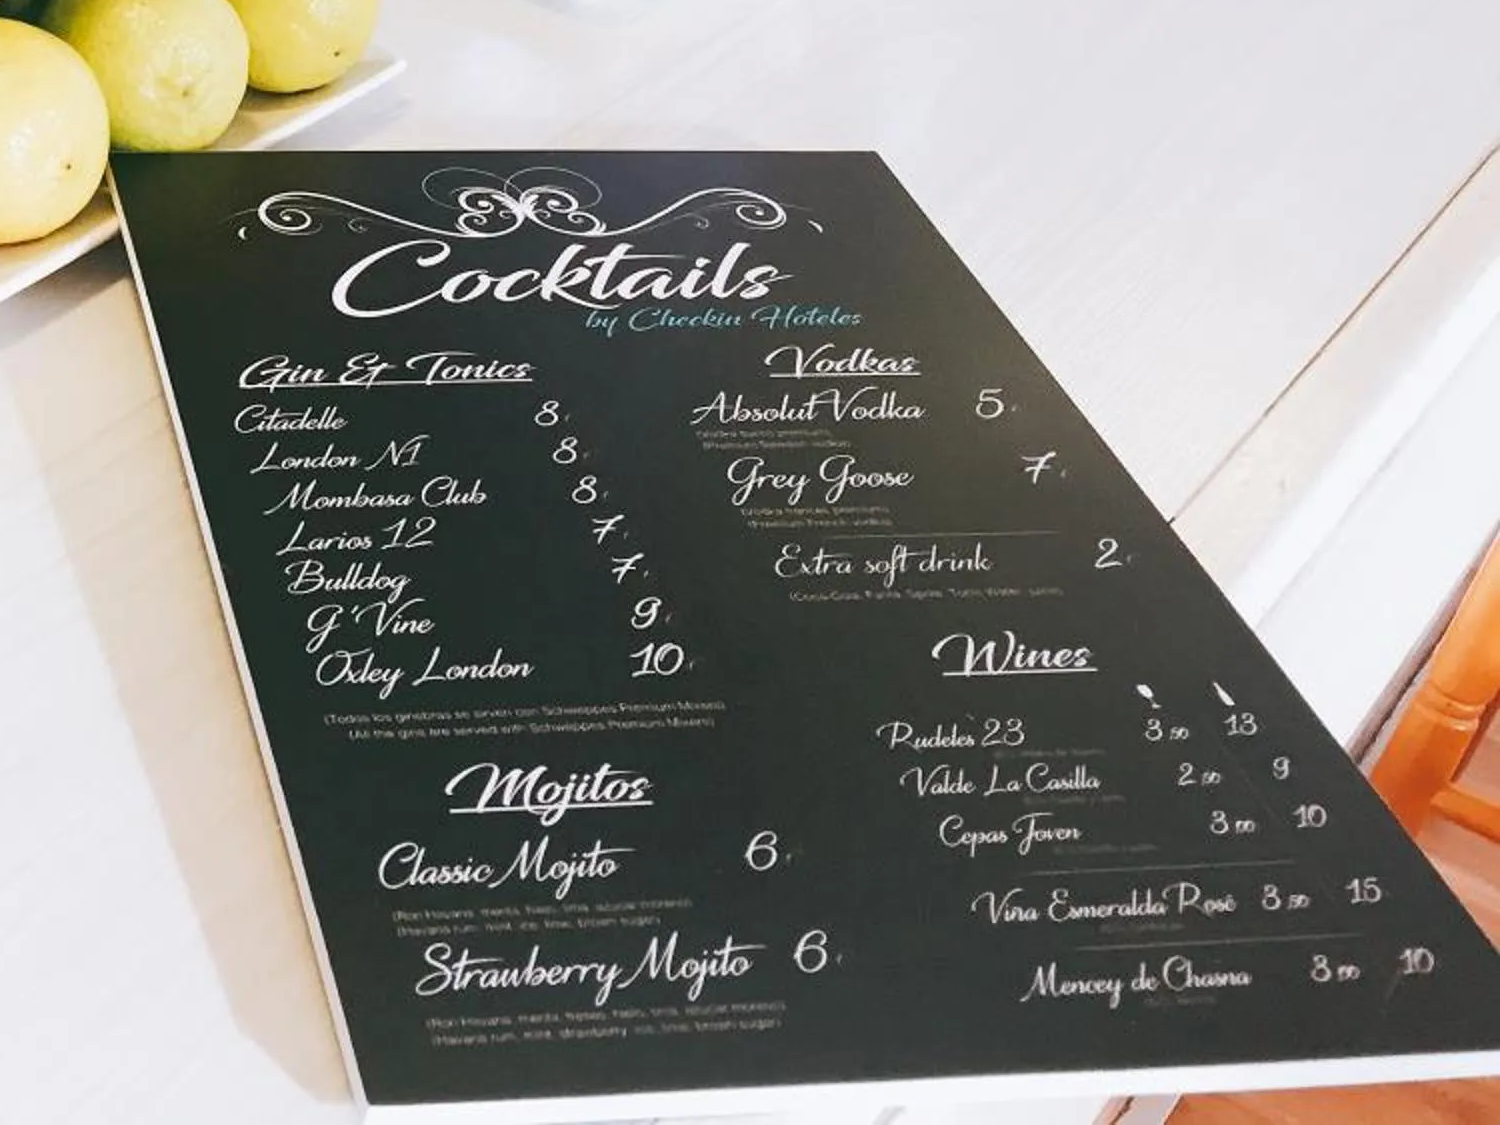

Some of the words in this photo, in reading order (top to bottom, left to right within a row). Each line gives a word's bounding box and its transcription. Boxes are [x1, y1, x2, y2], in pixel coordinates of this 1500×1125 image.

[331, 238, 794, 318] Cocktails
[586, 310, 618, 337] by
[628, 306, 741, 332] Checkin
[751, 305, 861, 330] Hoteles
[240, 355, 329, 393] Gin
[406, 351, 536, 386] Tonics
[764, 343, 922, 376] Vodkas
[234, 404, 348, 434] Citadelle
[534, 400, 560, 426] 8
[692, 391, 830, 426] Absolut
[822, 386, 926, 423] Vodka
[976, 388, 1003, 419] 5
[250, 441, 361, 475] London
[552, 436, 578, 464] 8
[727, 456, 811, 505] Grey
[819, 454, 915, 504] Goose
[1021, 450, 1057, 484] 7
[262, 479, 414, 515] Mombasa
[421, 476, 487, 508] Club
[571, 475, 597, 504] 8
[276, 521, 372, 556] Larios
[380, 516, 437, 550] 12
[592, 514, 625, 544] 7
[284, 559, 413, 603] Bulldog
[611, 552, 645, 584] 7
[774, 542, 852, 578] Extra
[864, 543, 916, 588] soft
[919, 542, 995, 573] drink
[1094, 538, 1122, 569] 2
[631, 596, 663, 630] 9
[316, 646, 405, 700] Oxley
[411, 646, 535, 686] London
[629, 641, 686, 678] 10
[931, 630, 1094, 676] Wines
[876, 721, 975, 753] Rudeles
[981, 718, 1025, 747] 23
[1145, 718, 1163, 742] 3
[1224, 712, 1258, 736] 13
[444, 762, 654, 827] Mojitos
[899, 764, 978, 797] Valde
[983, 764, 1022, 796] La
[1025, 762, 1102, 793] Casilla
[1177, 762, 1198, 787] 2
[1272, 756, 1291, 780] 9
[939, 814, 1009, 858] Cepas
[1011, 812, 1084, 856] Joven
[1209, 810, 1230, 835] 3
[1292, 803, 1328, 829] 10
[378, 841, 494, 890] Classic
[489, 834, 637, 901] Mojito
[744, 831, 778, 871] 6
[1047, 887, 1167, 922] Esmeralda
[1261, 884, 1282, 910] 3
[1346, 876, 1382, 904] 15
[416, 942, 620, 1006] Strawberry
[616, 930, 767, 1002] Mojito
[795, 929, 828, 973] 6
[1019, 961, 1122, 1009] Mencey
[1130, 961, 1161, 992] de
[1161, 954, 1253, 992] Chasna
[1311, 954, 1332, 982] 3
[1398, 946, 1435, 975] 10
